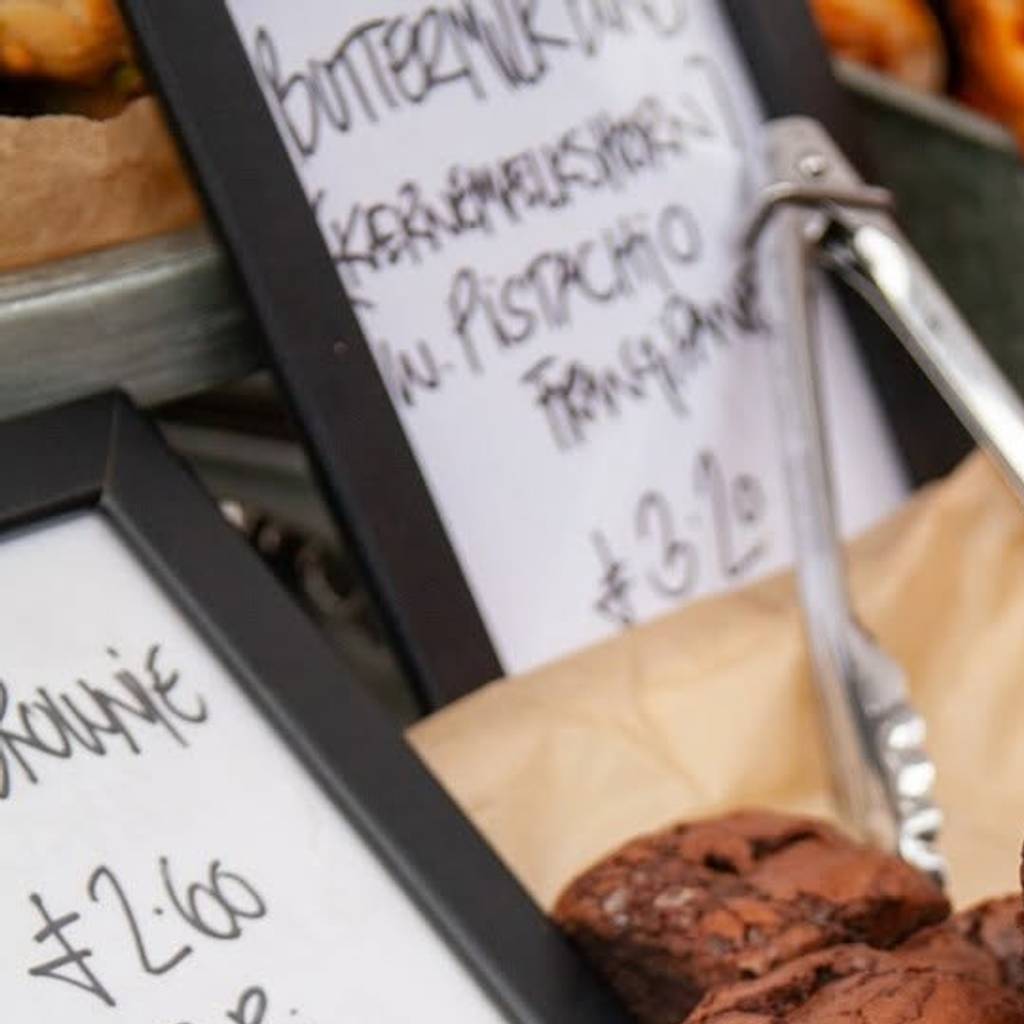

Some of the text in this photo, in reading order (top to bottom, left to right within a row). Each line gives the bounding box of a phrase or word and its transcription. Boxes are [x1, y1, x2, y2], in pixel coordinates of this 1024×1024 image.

[447, 204, 702, 375] PISTACHIO
[0, 644, 208, 800] ROWNIE
[28, 856, 267, 1007] £2.60
